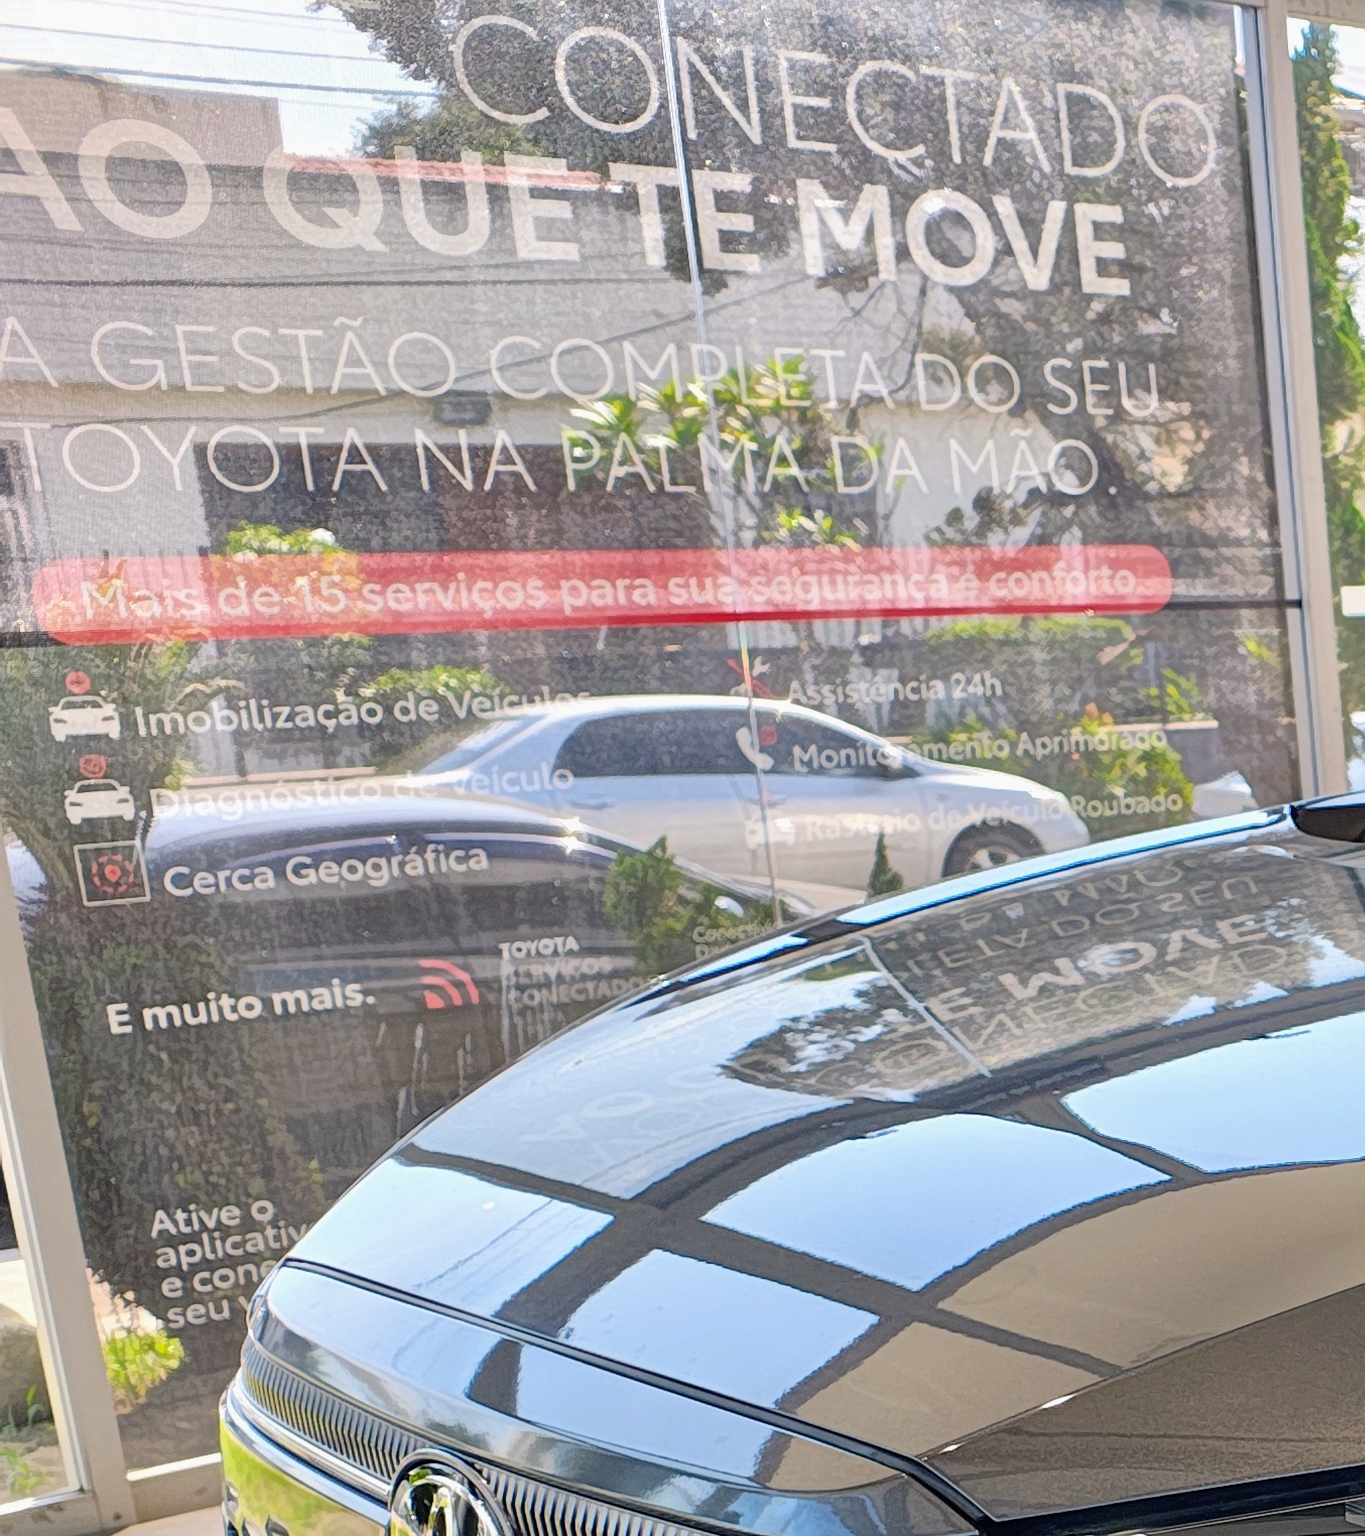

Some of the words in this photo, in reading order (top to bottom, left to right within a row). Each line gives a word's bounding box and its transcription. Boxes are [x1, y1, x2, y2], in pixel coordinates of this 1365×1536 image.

[454, 15, 1217, 188] CONECTADO
[262, 145, 580, 261] QUE
[608, 161, 761, 275] TE
[798, 178, 1131, 296] MOVE
[0, 316, 59, 388] A
[90, 317, 457, 397] GESTÃO
[491, 336, 896, 412] COMPLETA
[914, 353, 1021, 415] DO
[1044, 358, 1160, 417] SEU
[0, 421, 387, 493] TOYOTA
[413, 427, 538, 493] NA
[563, 429, 810, 496] PALMA
[832, 437, 929, 496] DA
[949, 428, 1118, 497] MÃO.
[80, 573, 200, 620] Mais
[218, 575, 279, 615] de
[297, 574, 346, 613] 15
[361, 573, 546, 618] serviços
[561, 577, 658, 616] para
[667, 577, 736, 605] sua
[745, 570, 949, 609] segurança
[989, 562, 1137, 599] conforto
[135, 698, 383, 737] Imobilização
[393, 693, 440, 723] de
[445, 686, 591, 721] Veículos
[788, 672, 947, 706] Assistência
[952, 671, 1003, 699] 24h
[793, 732, 1010, 772] Monitoamento
[1016, 726, 1167, 762] Aprimorado
[150, 779, 382, 822] Diagnóstico
[1070, 790, 1184, 820] Roubado
[164, 864, 275, 898] Cerca
[285, 844, 489, 887] Geográfica
[498, 935, 580, 961] TOYOTA
[106, 1002, 133, 1035] E
[142, 991, 263, 1031] muito
[270, 977, 376, 1015] mais.
[151, 1203, 241, 1239] Ative
[251, 1200, 274, 1222] o
[155, 1220, 313, 1272] aplicativ
[161, 1276, 184, 1298] e
[193, 1259, 277, 1293] cone
[167, 1298, 231, 1329] seu
